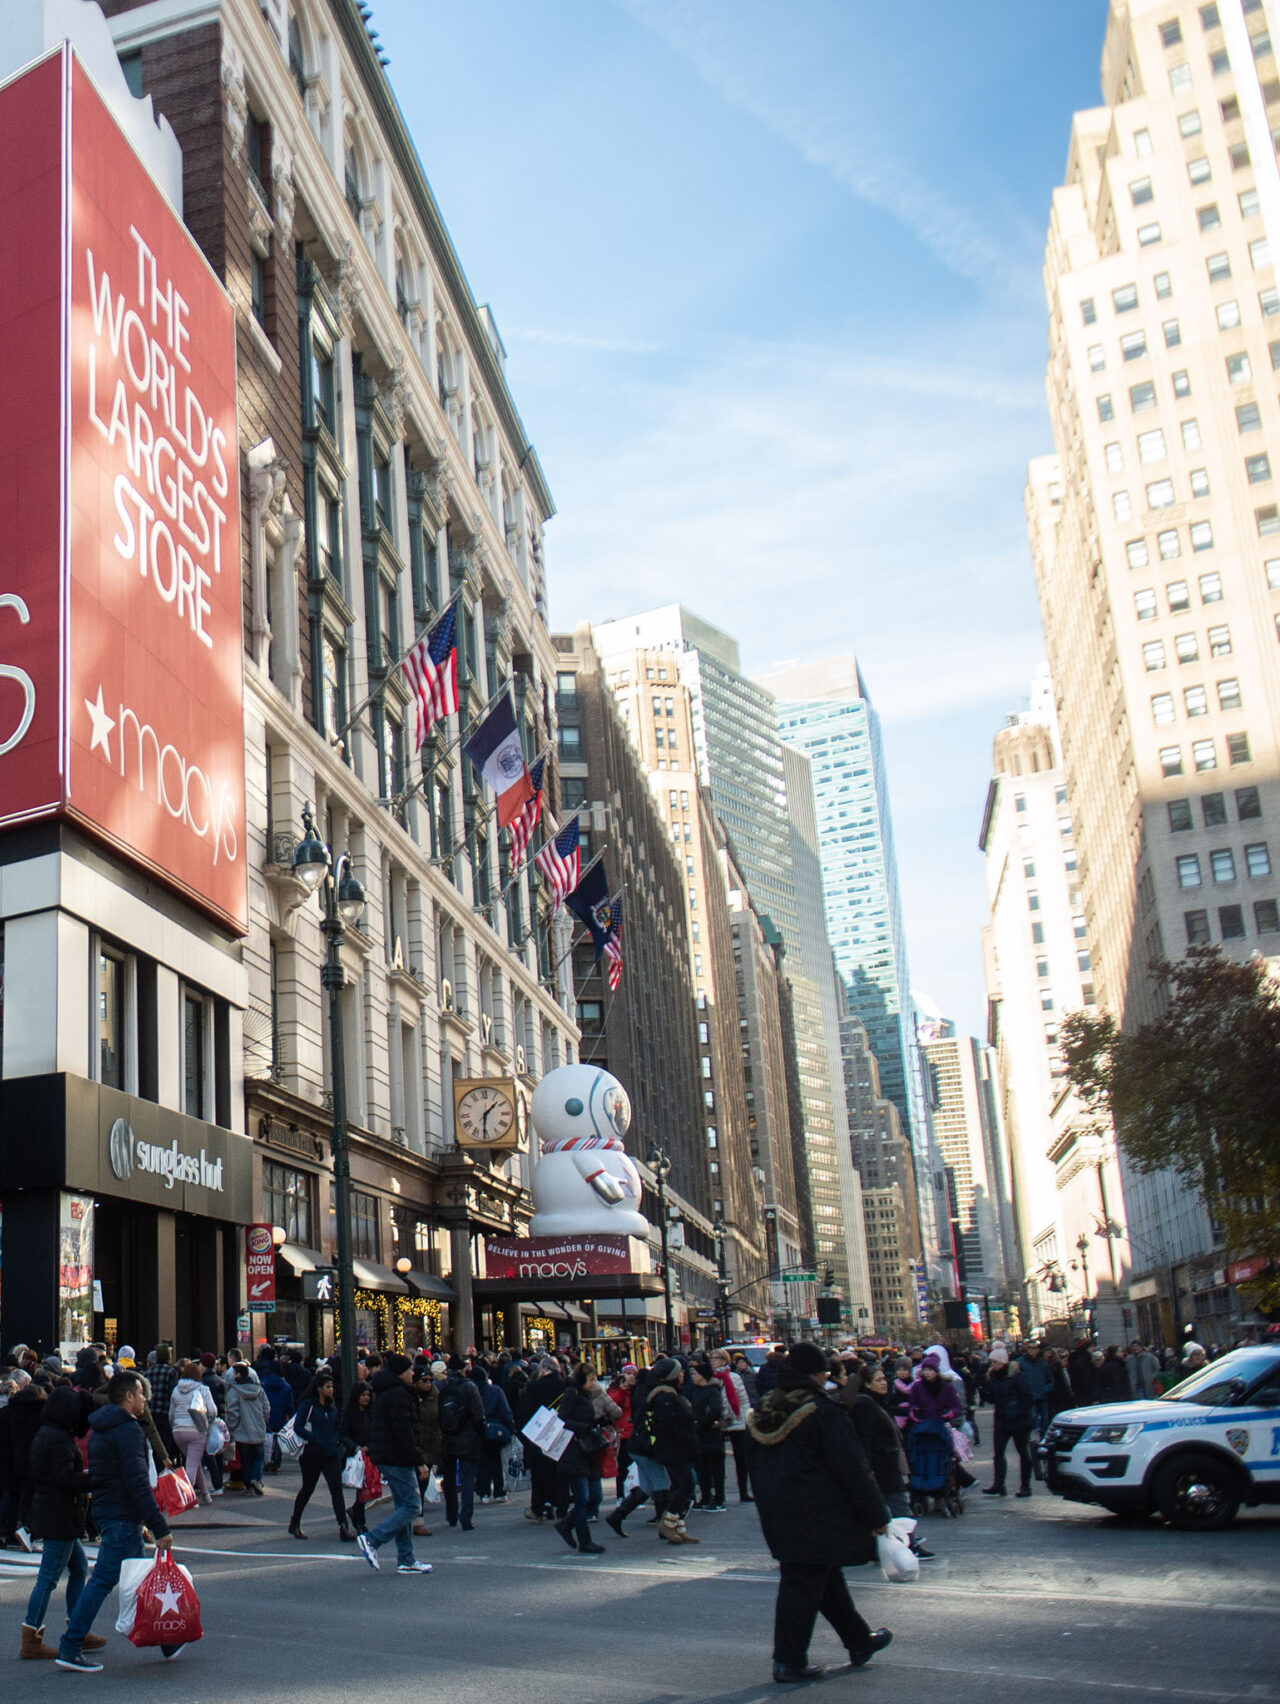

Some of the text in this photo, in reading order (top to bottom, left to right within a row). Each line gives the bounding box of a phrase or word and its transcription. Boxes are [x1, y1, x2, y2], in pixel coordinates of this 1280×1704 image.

[130, 224, 191, 373] THE
[86, 247, 228, 499] WORLD'S
[89, 342, 226, 574] LARGEST
[113, 474, 213, 649] STORE
[120, 702, 237, 866] macy's
[136, 1139, 224, 1192] sunglass hut
[252, 1237, 269, 1247] KING
[487, 1243, 519, 1257] BELIEVE
[532, 1250, 547, 1258] THE
[548, 1244, 582, 1255] WONDER
[585, 1244, 595, 1252] OF
[598, 1244, 627, 1258] GIVING
[248, 1265, 274, 1275] OPEN
[249, 1255, 272, 1264] NOW
[520, 1257, 587, 1281] macy's
[1167, 1416, 1207, 1428] POLICE
[153, 1619, 186, 1631] macy's
